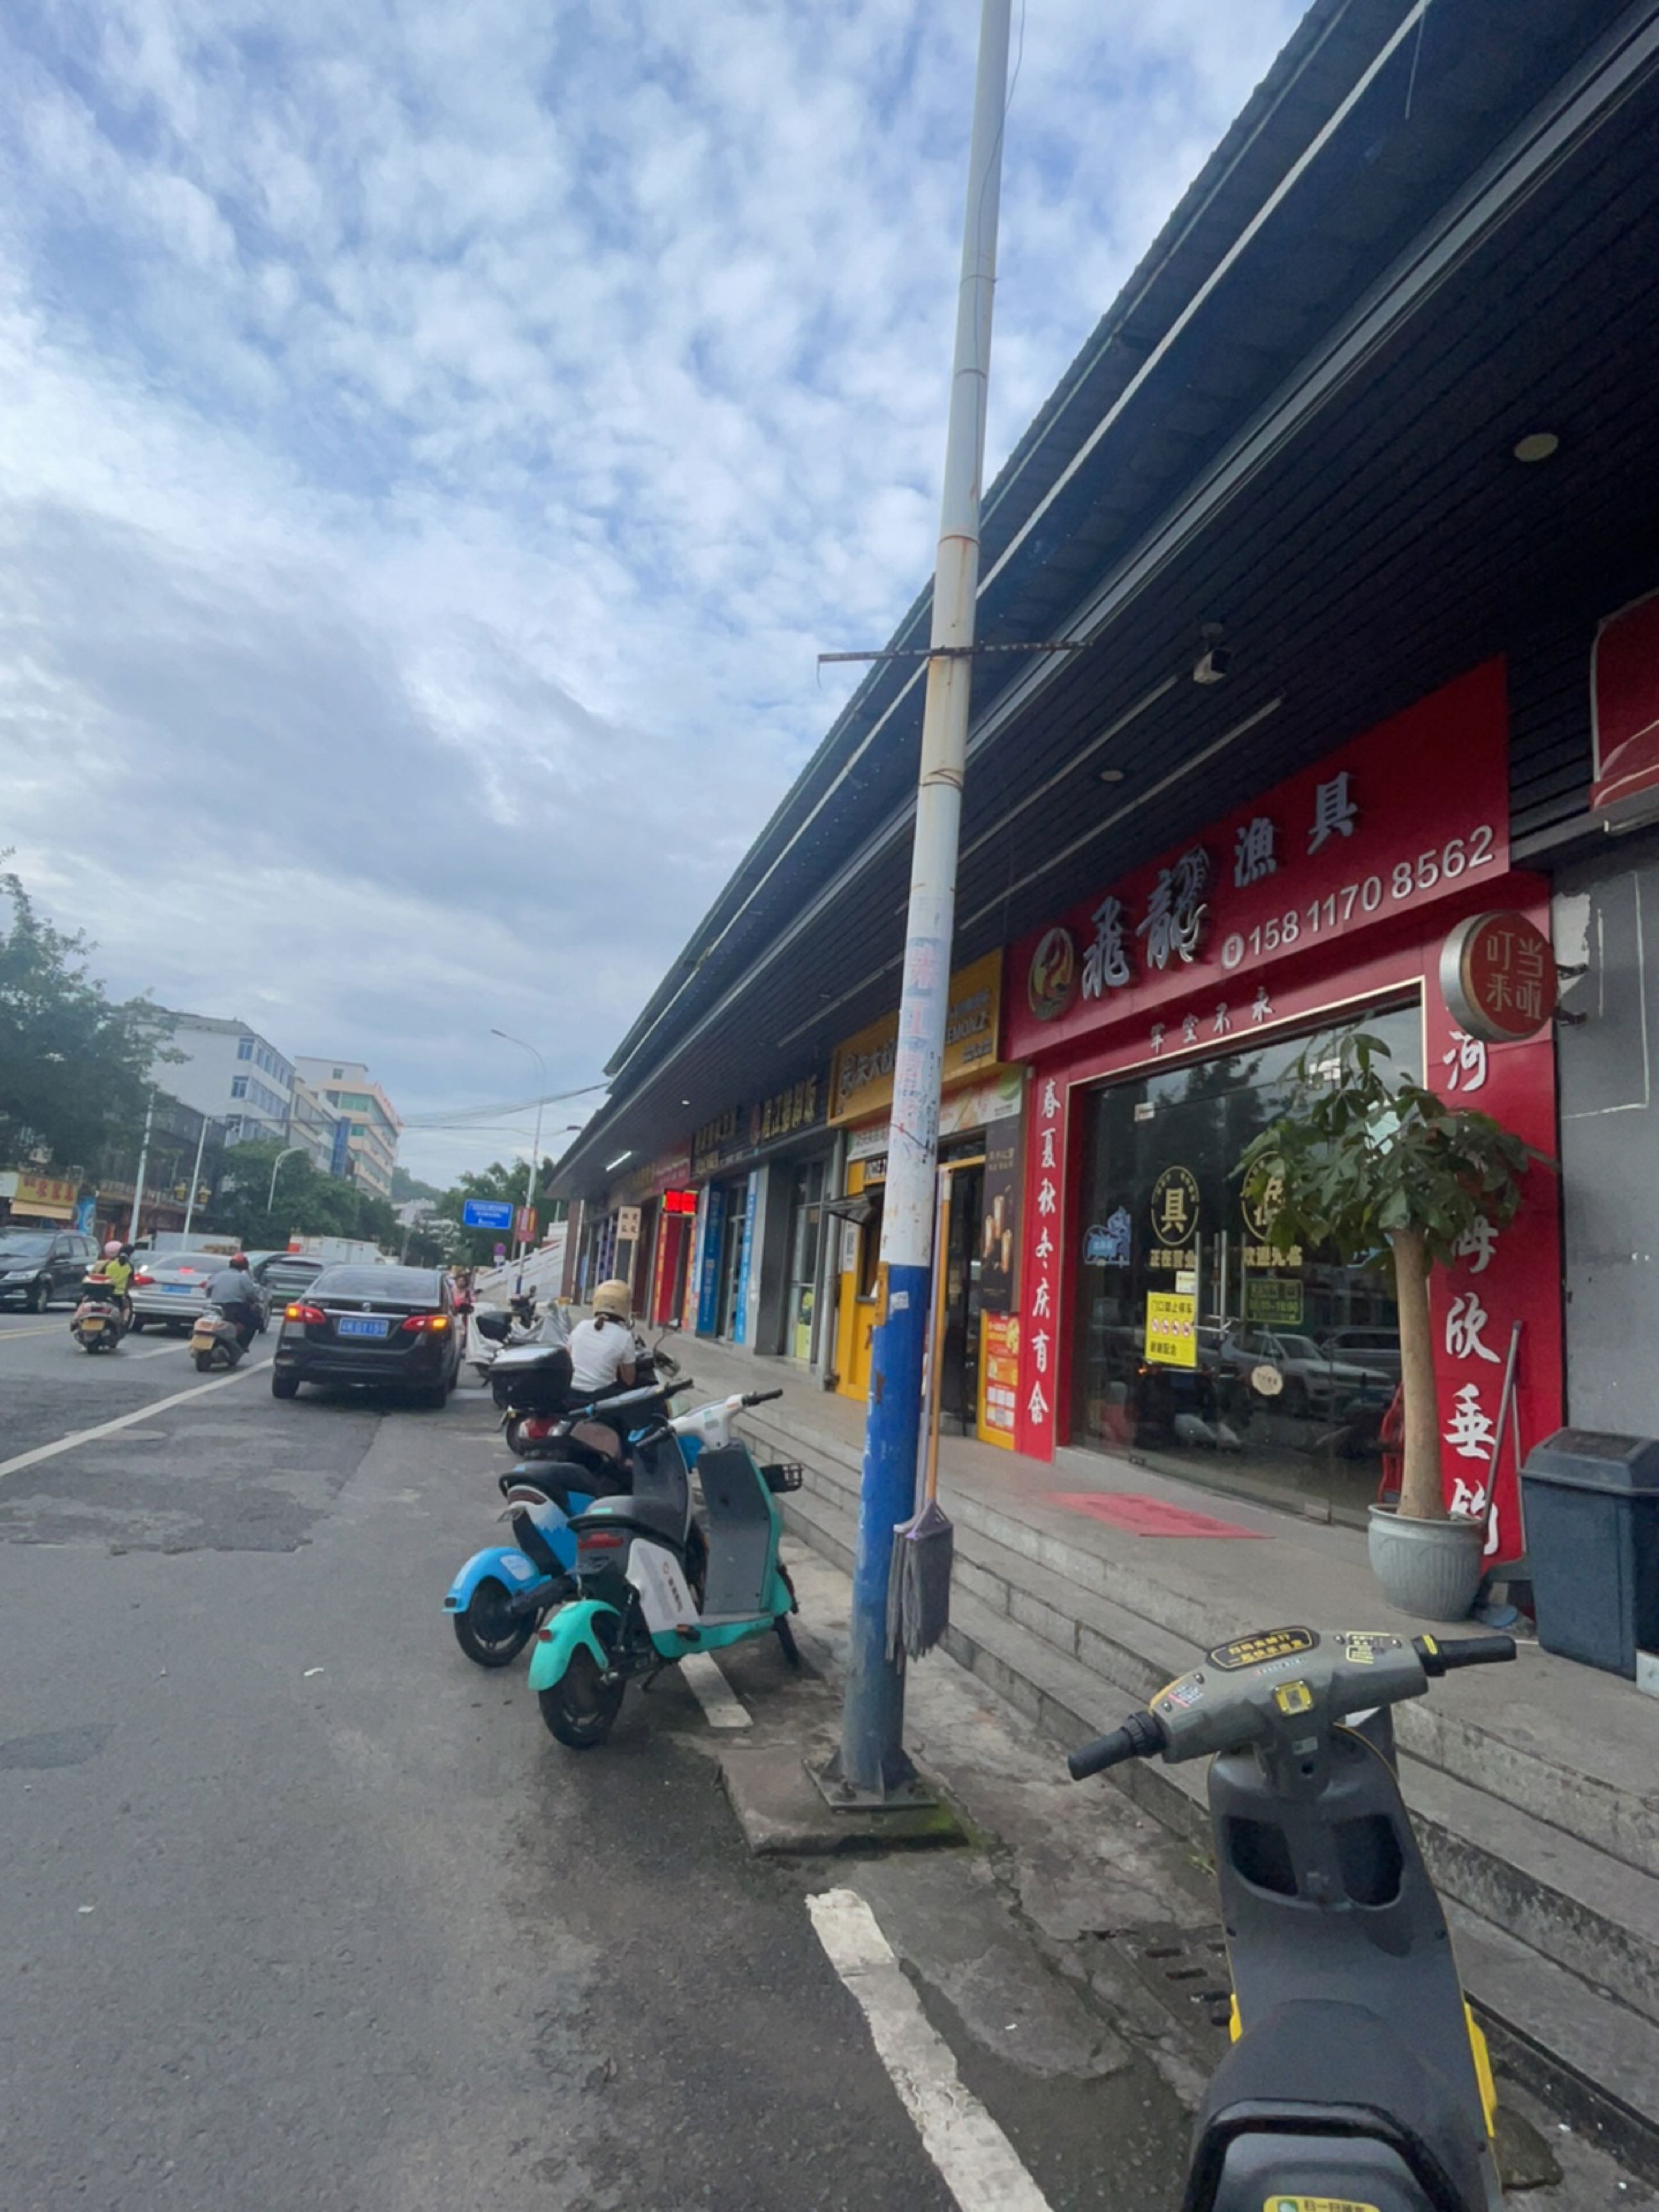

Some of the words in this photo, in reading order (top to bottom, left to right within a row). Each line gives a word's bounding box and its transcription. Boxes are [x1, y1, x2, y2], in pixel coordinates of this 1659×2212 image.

[1249, 910, 1299, 956] 158
[1307, 876, 1382, 933] 1170
[1391, 825, 1494, 899] 8562
[1161, 1187, 1187, 1233] 具
